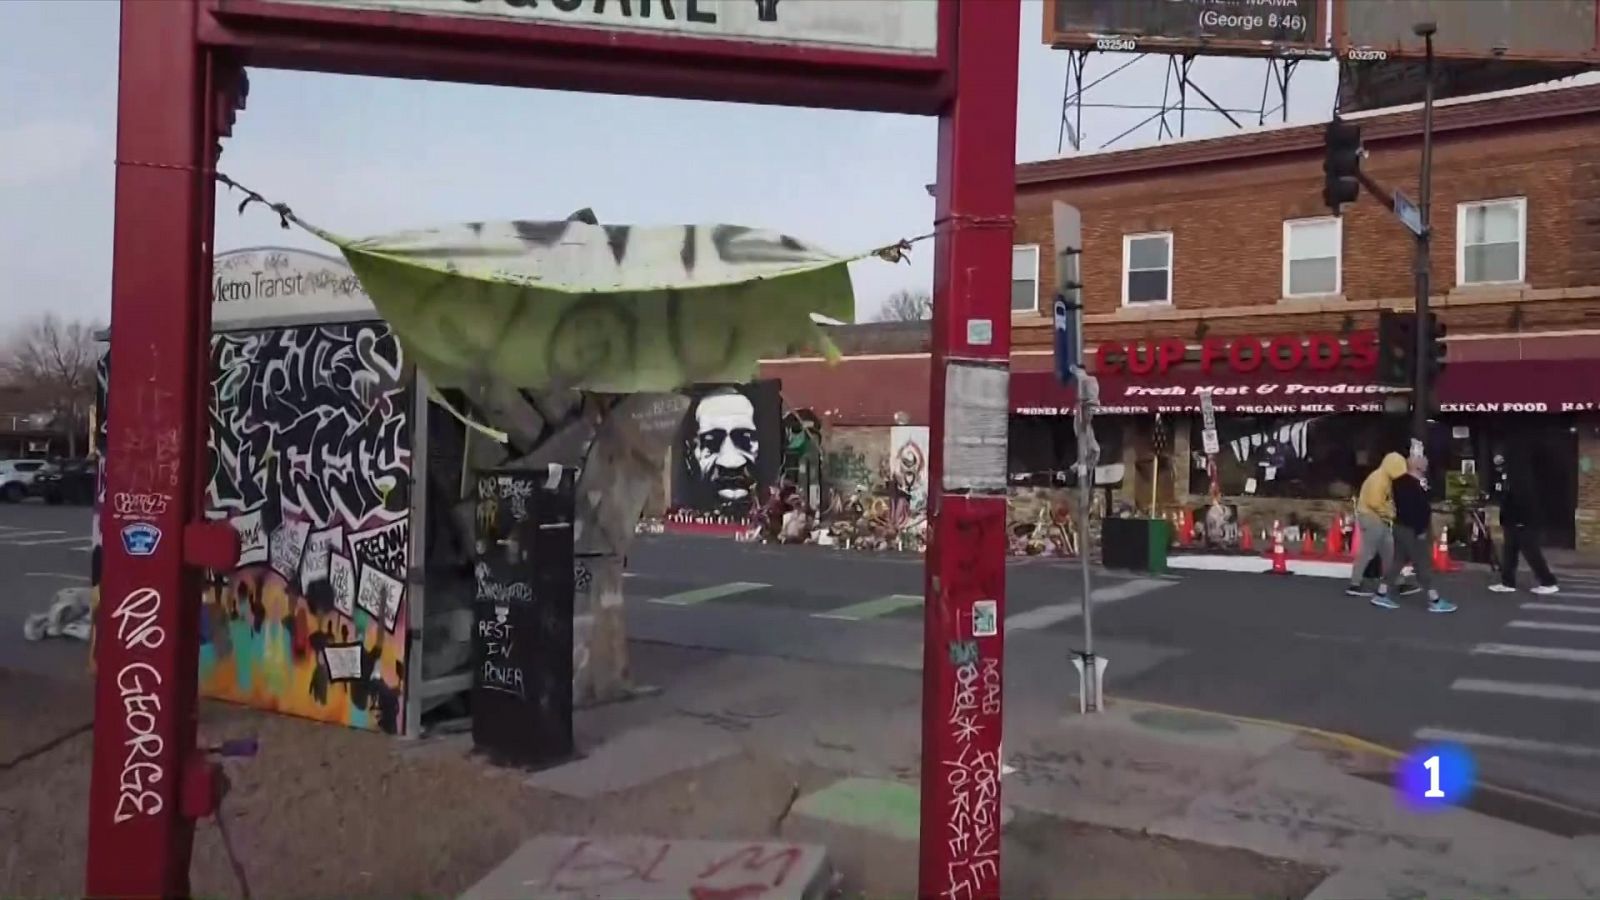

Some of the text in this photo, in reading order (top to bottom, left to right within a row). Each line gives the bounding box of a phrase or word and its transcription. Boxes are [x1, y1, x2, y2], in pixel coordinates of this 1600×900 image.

[1199, 11, 1307, 34] (George 8:46)
[252, 271, 303, 299] Transit
[1095, 332, 1380, 375] CUP FOODS
[1124, 386, 1186, 396] Fresh
[1192, 385, 1250, 396] Meat
[1256, 384, 1279, 395] &
[1236, 405, 1297, 413] ORGANIC
[1301, 404, 1335, 412] MILK
[1503, 402, 1547, 412] FOOD
[479, 620, 514, 639] REST
[486, 642, 513, 659] IN
[484, 660, 525, 694] POWER
[114, 662, 164, 823] GEORGE
[970, 750, 999, 889] FORGIVE
